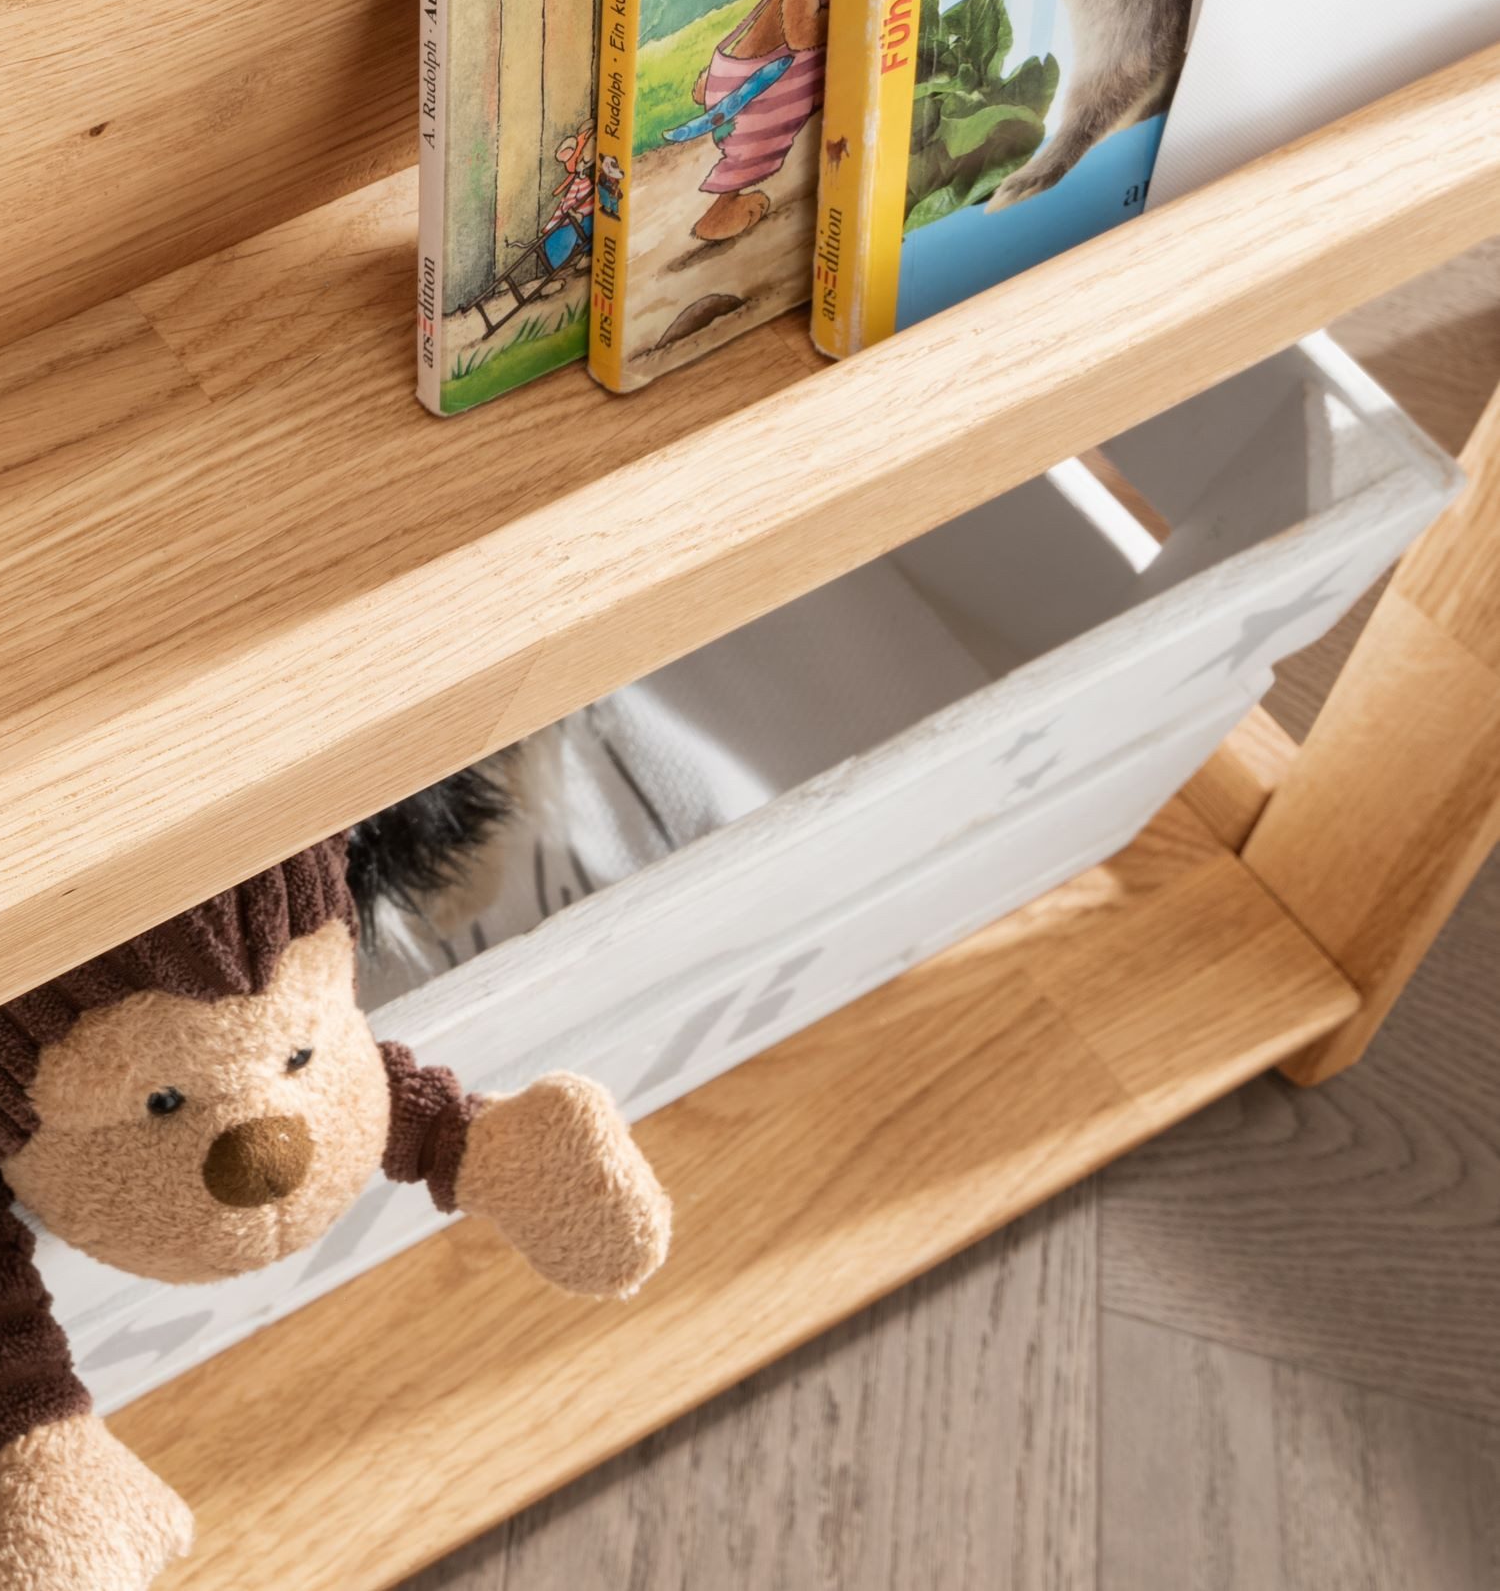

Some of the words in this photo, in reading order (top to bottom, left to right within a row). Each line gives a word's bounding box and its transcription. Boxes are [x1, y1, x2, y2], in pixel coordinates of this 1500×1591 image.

[609, 22, 626, 54] Ein
[422, 39, 441, 121] Rudolph
[604, 71, 626, 140] Rudolph
[422, 128, 436, 150] A.
